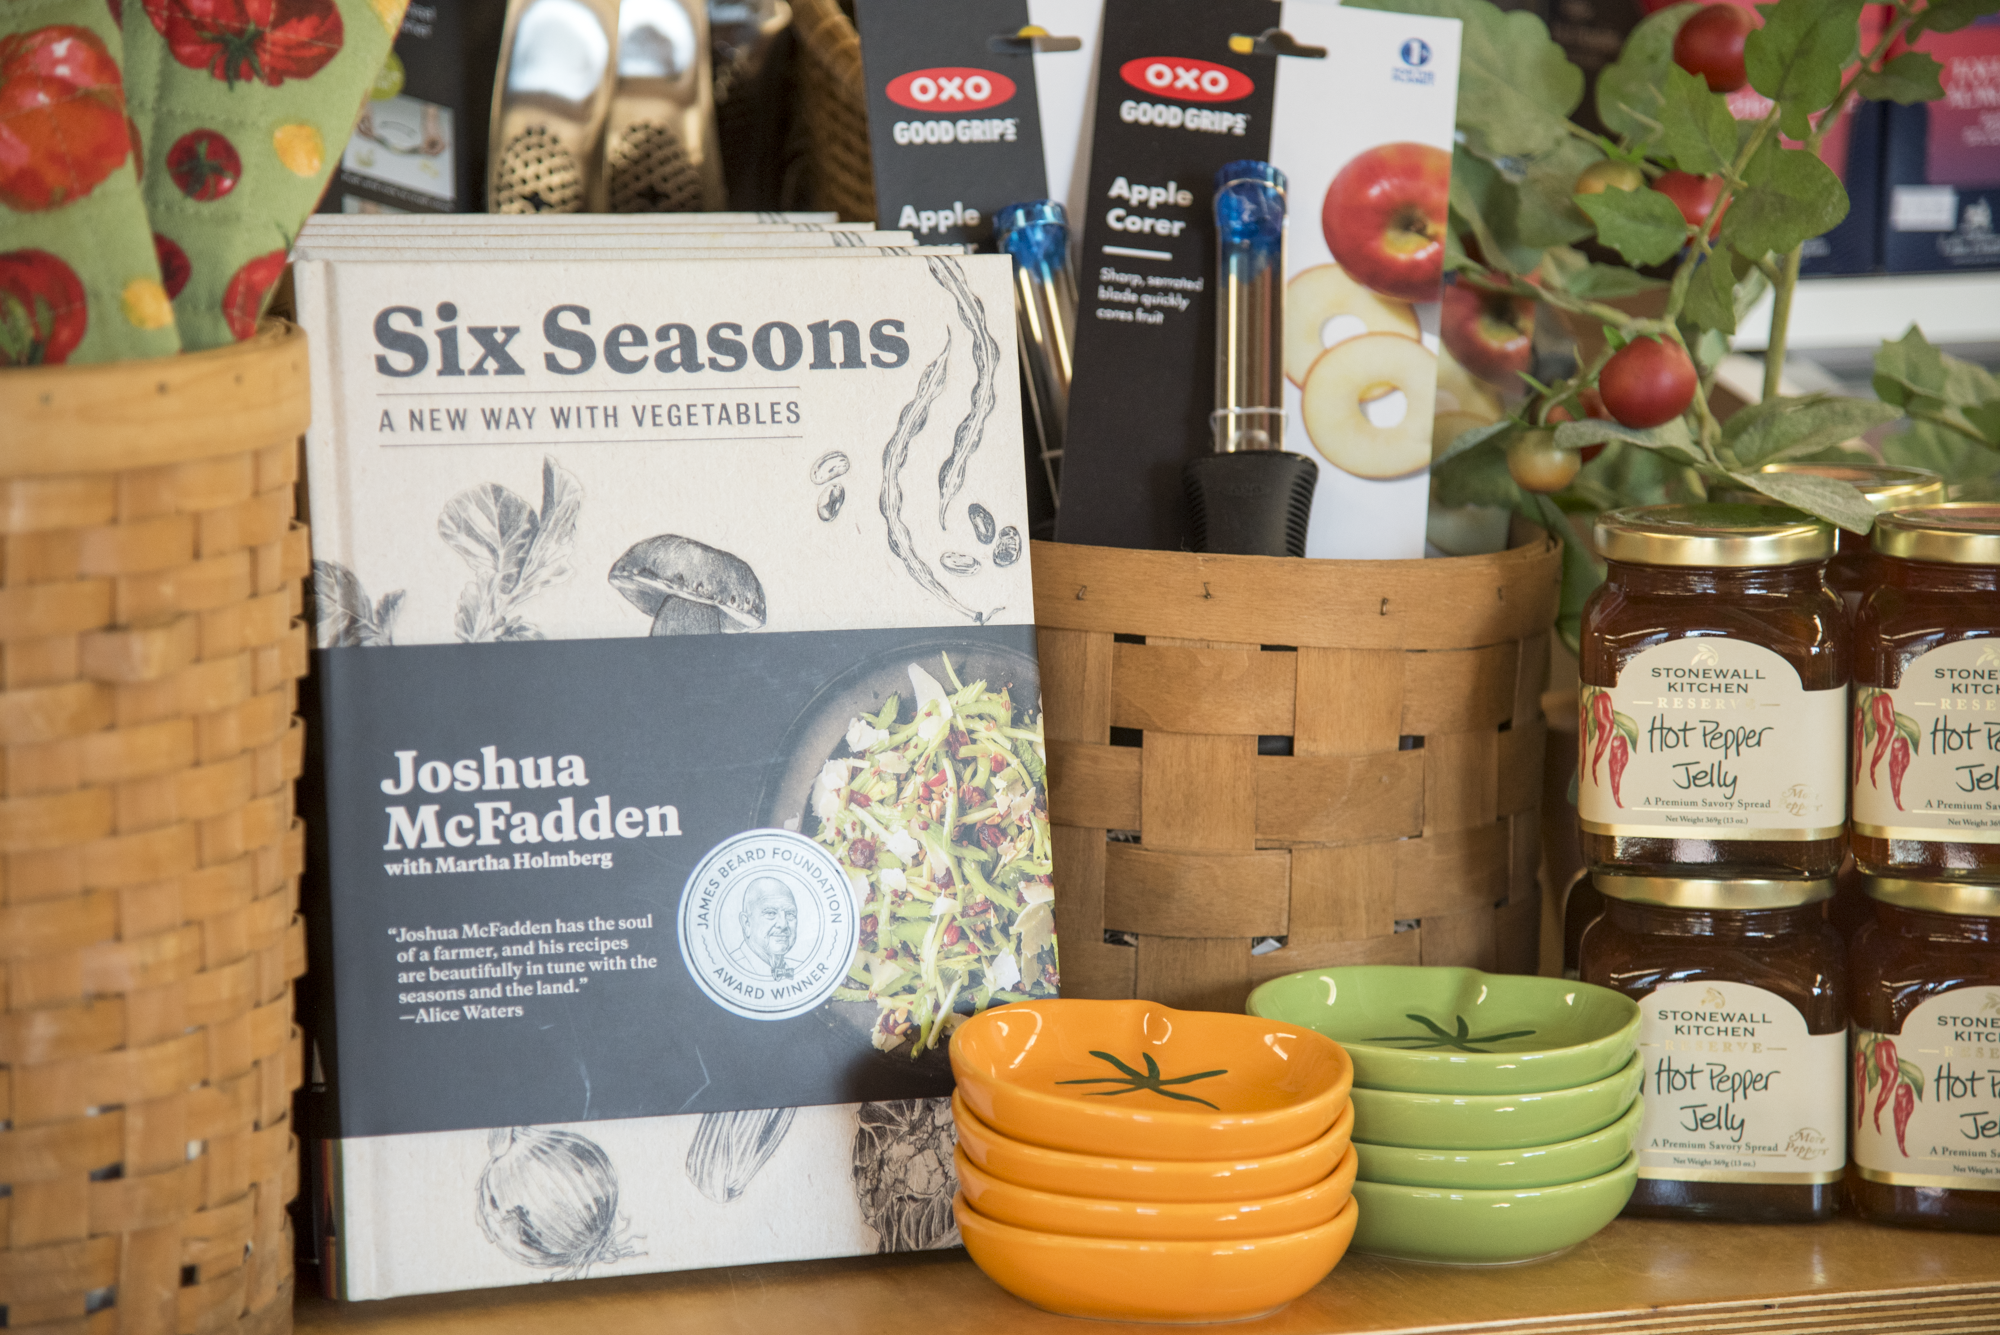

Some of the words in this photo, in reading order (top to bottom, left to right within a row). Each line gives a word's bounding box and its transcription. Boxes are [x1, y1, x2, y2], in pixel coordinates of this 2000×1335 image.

[909, 74, 993, 103] OXO
[1144, 62, 1230, 95] OXO
[893, 119, 955, 145] GOOD
[956, 117, 1018, 143] GRIPS
[1119, 100, 1183, 128] GOOD
[1184, 106, 1247, 136] GRIPS
[1107, 176, 1194, 209] Apple
[898, 200, 981, 235] Apple
[1105, 207, 1186, 238] Corer
[1099, 266, 1146, 288] Sharp,
[1146, 275, 1205, 292] serrated
[1097, 284, 1139, 304] blade
[1140, 292, 1191, 312] quickly
[1095, 307, 1134, 322] cores
[1134, 307, 1165, 325] fruit
[373, 301, 525, 377] Six
[542, 304, 911, 375] Seasons
[379, 409, 396, 432] A
[409, 408, 467, 432] NEW
[483, 406, 537, 430] WAY
[551, 404, 619, 429] WITH
[633, 401, 801, 427] VEGETABLES
[1651, 667, 1767, 680] STONEWALL
[1934, 668, 2000, 680] STONE
[1667, 682, 1749, 694] KITCHEN
[1648, 713, 1697, 753] Hot
[1699, 719, 1774, 760] Pepper
[1930, 714, 1982, 755] Hot
[380, 745, 590, 795] Joshua
[1672, 760, 1738, 800] Jelly
[1643, 796, 1652, 806] A
[1655, 798, 1698, 808] Premium
[1701, 798, 1735, 810] Savory
[1737, 798, 1771, 811] Spread
[1782, 787, 1819, 800] Moe
[1925, 799, 1933, 809] A
[1937, 800, 1982, 810] Premium
[383, 795, 682, 851] McFadden
[1665, 814, 1678, 822] Net
[1679, 814, 1704, 825] Weight
[1705, 816, 1722, 825] 369g
[1723, 815, 1734, 824] (13
[1735, 816, 1749, 825] oz.)
[1948, 818, 1961, 826] Net
[1962, 818, 1988, 828] Weight
[384, 858, 433, 876] with
[435, 854, 510, 873] Martha
[513, 850, 613, 869] Holmberg
[697, 878, 720, 930] JAMES
[718, 848, 766, 878] BEARD
[772, 847, 842, 923] FOUNDATION
[387, 926, 459, 943] “Joshua
[461, 920, 552, 939] McFadden
[556, 918, 585, 936] has
[588, 916, 616, 933] the
[618, 913, 653, 930] soul
[396, 947, 417, 963] of
[419, 951, 430, 962] a
[434, 945, 499, 961] farmer,
[501, 940, 534, 957] and
[538, 939, 564, 954] his
[568, 937, 629, 955] recipes
[397, 970, 426, 983] are
[428, 961, 523, 981] beautifully
[526, 961, 544, 976] in
[546, 960, 586, 974] tune
[588, 956, 627, 972] with
[630, 954, 658, 969] the
[713, 967, 765, 1000] AWARD
[771, 962, 829, 1000] WINNER
[398, 989, 466, 1004] seasons
[469, 983, 502, 1000] and
[505, 981, 533, 997] the
[536, 977, 589, 995] land.”
[462, 1004, 524, 1020] Waters
[1658, 1010, 1772, 1024] STONEWALL
[1674, 1025, 1755, 1037] KITCHEN
[1954, 1031, 2000, 1043] KITC
[1655, 1056, 1704, 1095] Hot
[1706, 1062, 1781, 1103] Pepper
[1934, 1062, 1985, 1102] Hot
[1680, 1103, 1745, 1143] Jelly
[1960, 1111, 2000, 1140] Je
[1651, 1138, 1659, 1148] A
[1662, 1138, 1706, 1149] Premium
[1709, 1140, 1743, 1153] Savory
[1745, 1141, 1778, 1153] Spread
[1789, 1131, 1826, 1144] More
[1673, 1156, 1686, 1165] Net
[1687, 1157, 1712, 1168] Weight
[1713, 1158, 1729, 1168] 369g
[1930, 1146, 1938, 1155] A
[1942, 1146, 1987, 1158] Premium
[1953, 1164, 1966, 1173] Net
[1967, 1165, 1993, 1176] Weight
